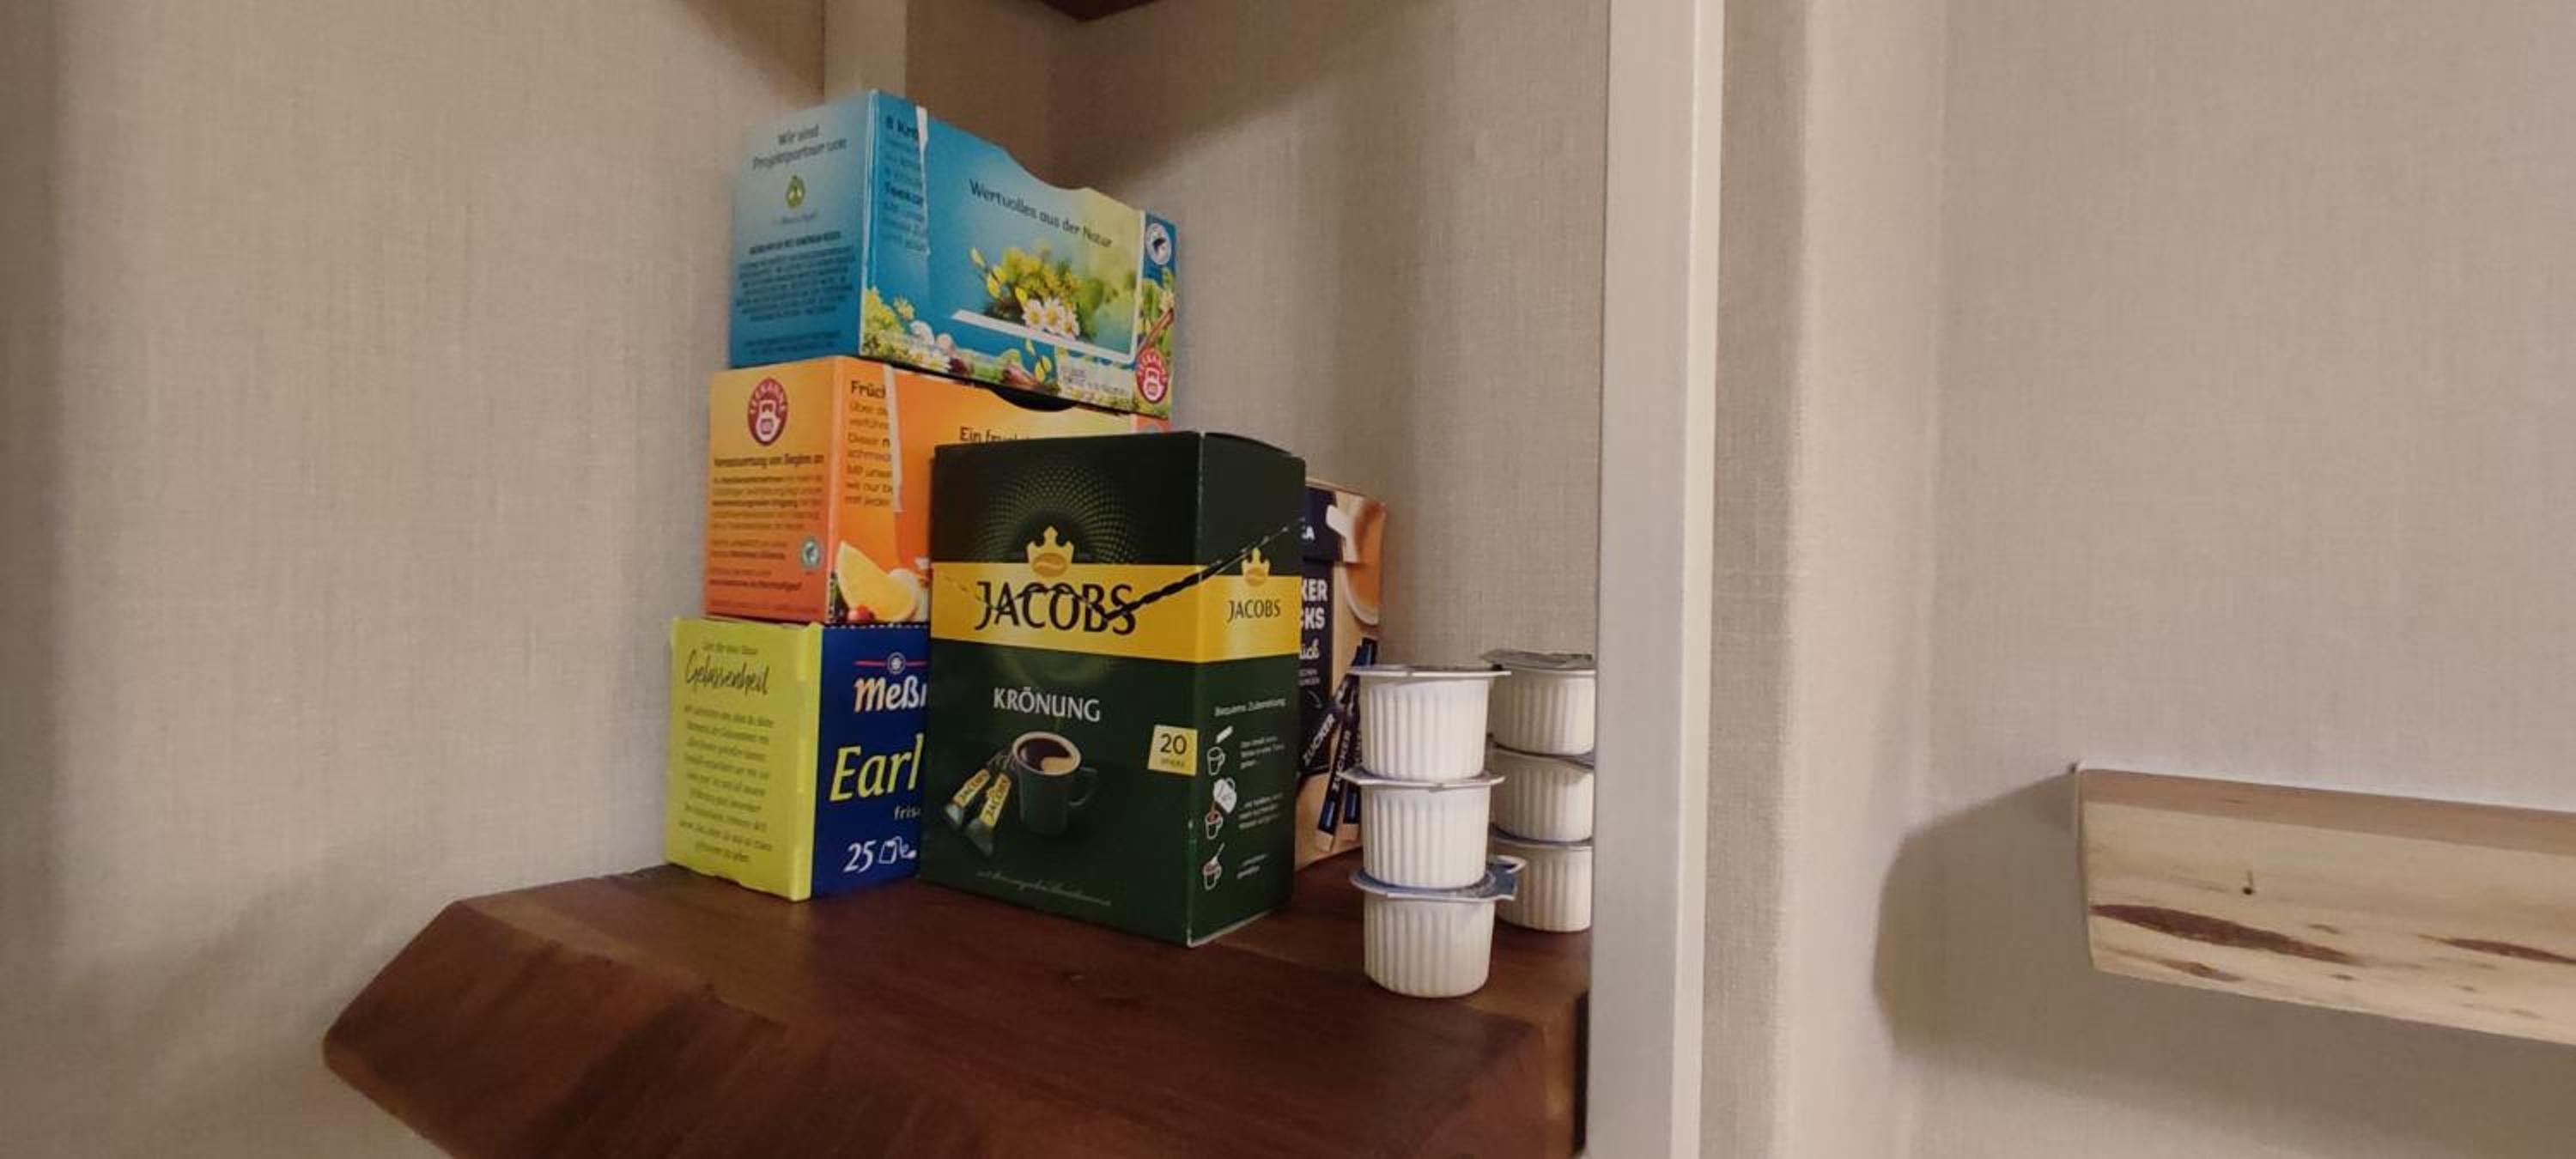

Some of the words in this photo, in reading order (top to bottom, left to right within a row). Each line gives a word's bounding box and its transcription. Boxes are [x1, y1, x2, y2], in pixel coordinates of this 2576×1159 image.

[1039, 211, 1060, 228] aus
[1062, 219, 1080, 234] der
[1083, 226, 1113, 248] Natur
[959, 426, 981, 443] Ein
[974, 580, 1137, 636] JACOBS
[1226, 598, 1282, 623] JACOBS
[993, 686, 1101, 723] KRÖNUNG
[1160, 732, 1188, 755] 20
[1303, 713, 1335, 768] ZUCKER
[829, 731, 926, 803] Earl
[842, 839, 878, 874] 25
